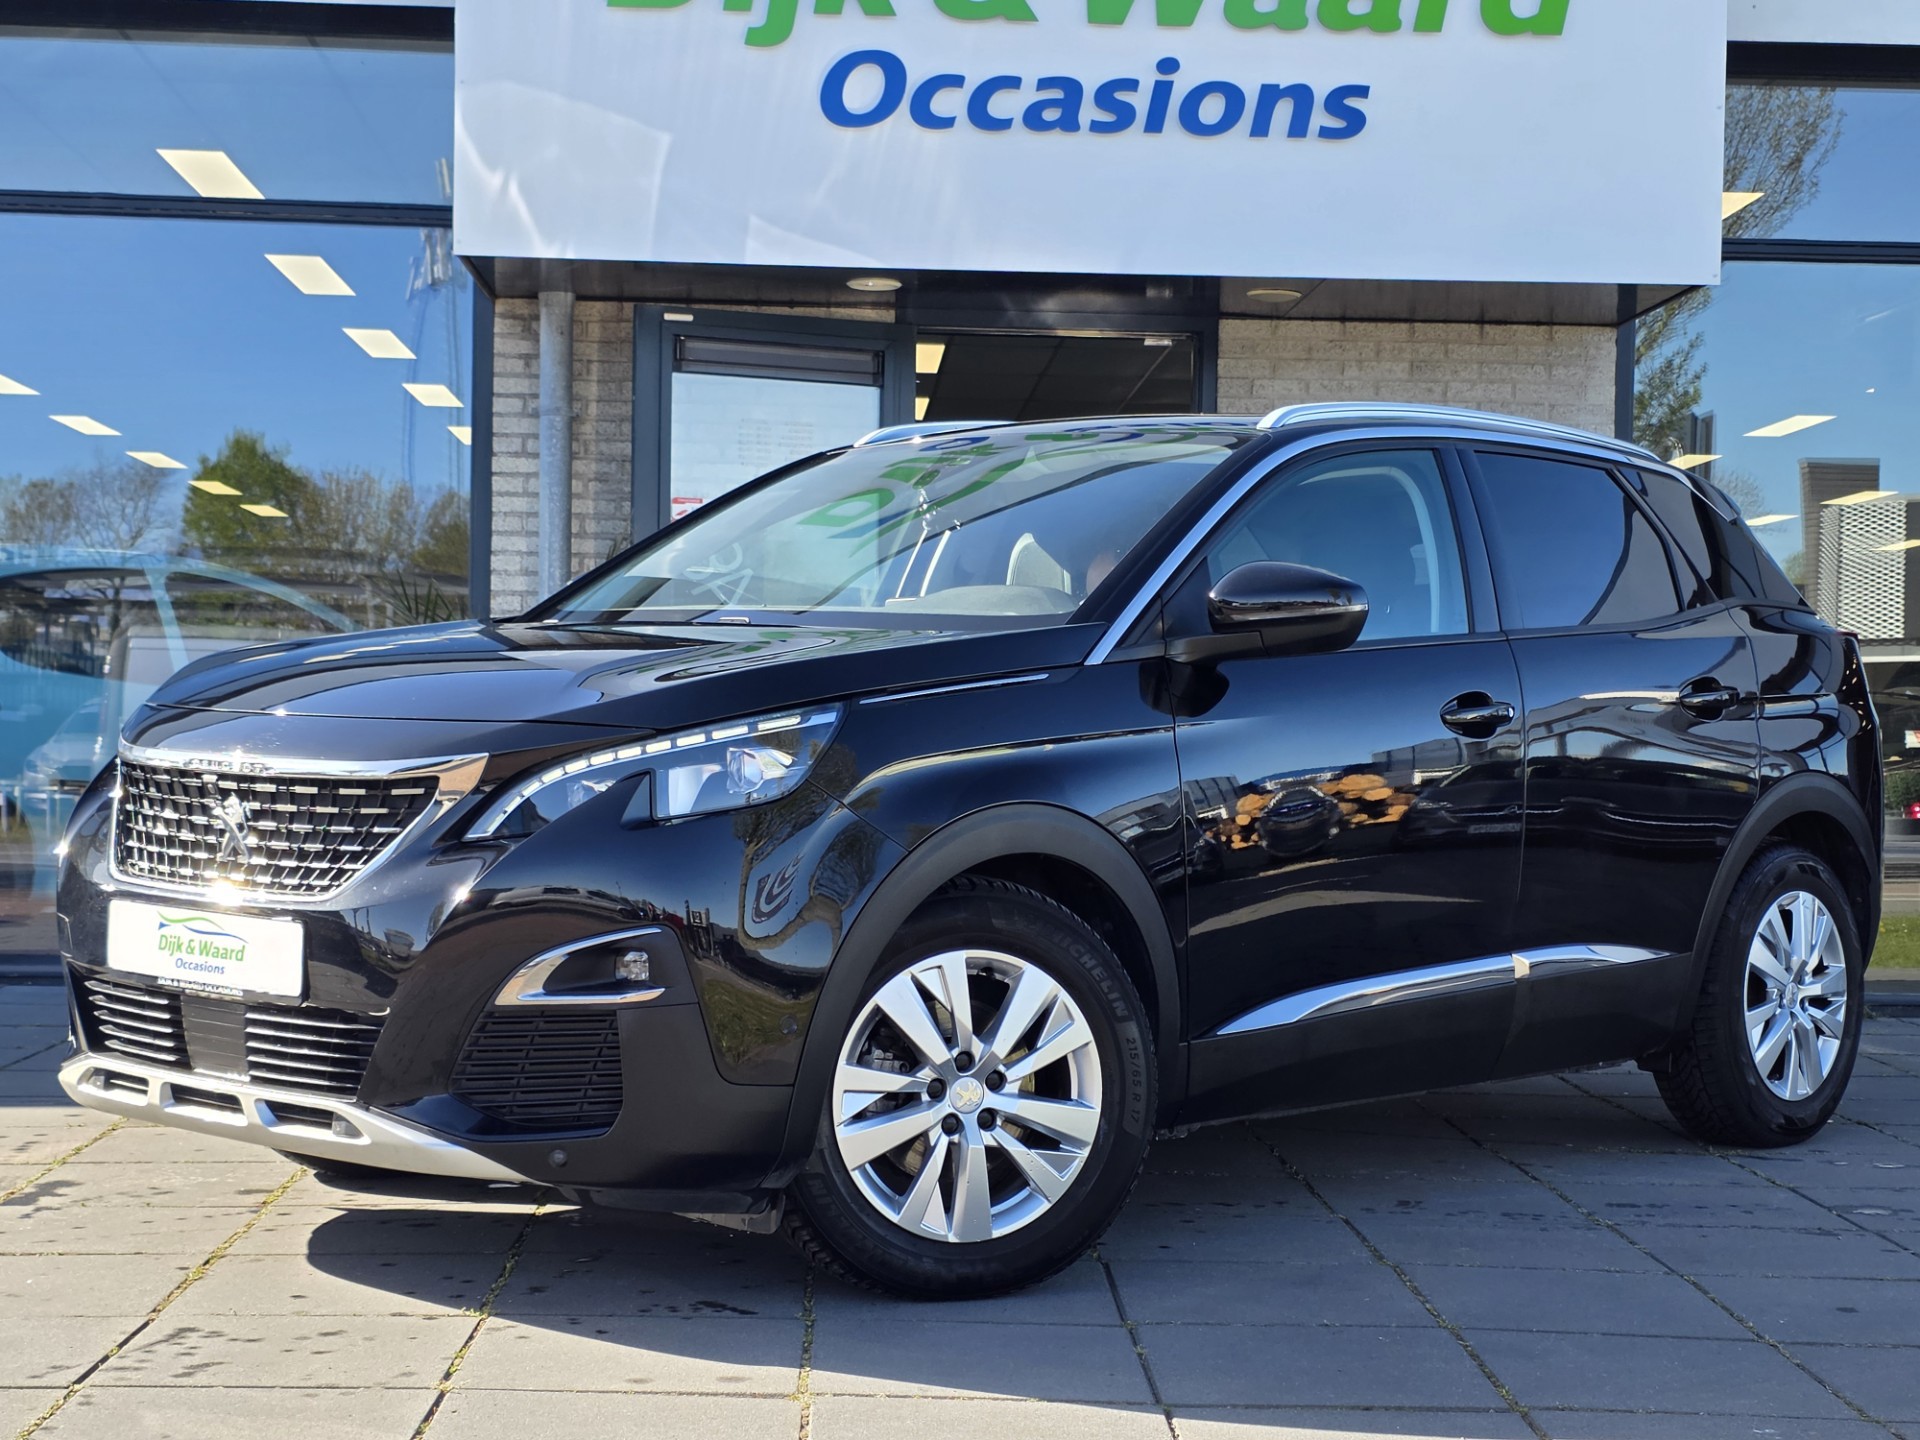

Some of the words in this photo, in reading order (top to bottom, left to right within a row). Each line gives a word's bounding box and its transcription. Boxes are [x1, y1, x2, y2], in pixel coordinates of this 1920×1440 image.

[821, 50, 1369, 139] Occasions
[189, 758, 267, 773] PEUGOT
[158, 934, 183, 957] Dijk
[185, 939, 196, 955] &
[199, 940, 246, 962] Waard
[175, 957, 225, 975] Occasions
[1126, 1037, 1143, 1090] 215/65
[1133, 1092, 1143, 1102] R
[1130, 1109, 1142, 1123] 17
